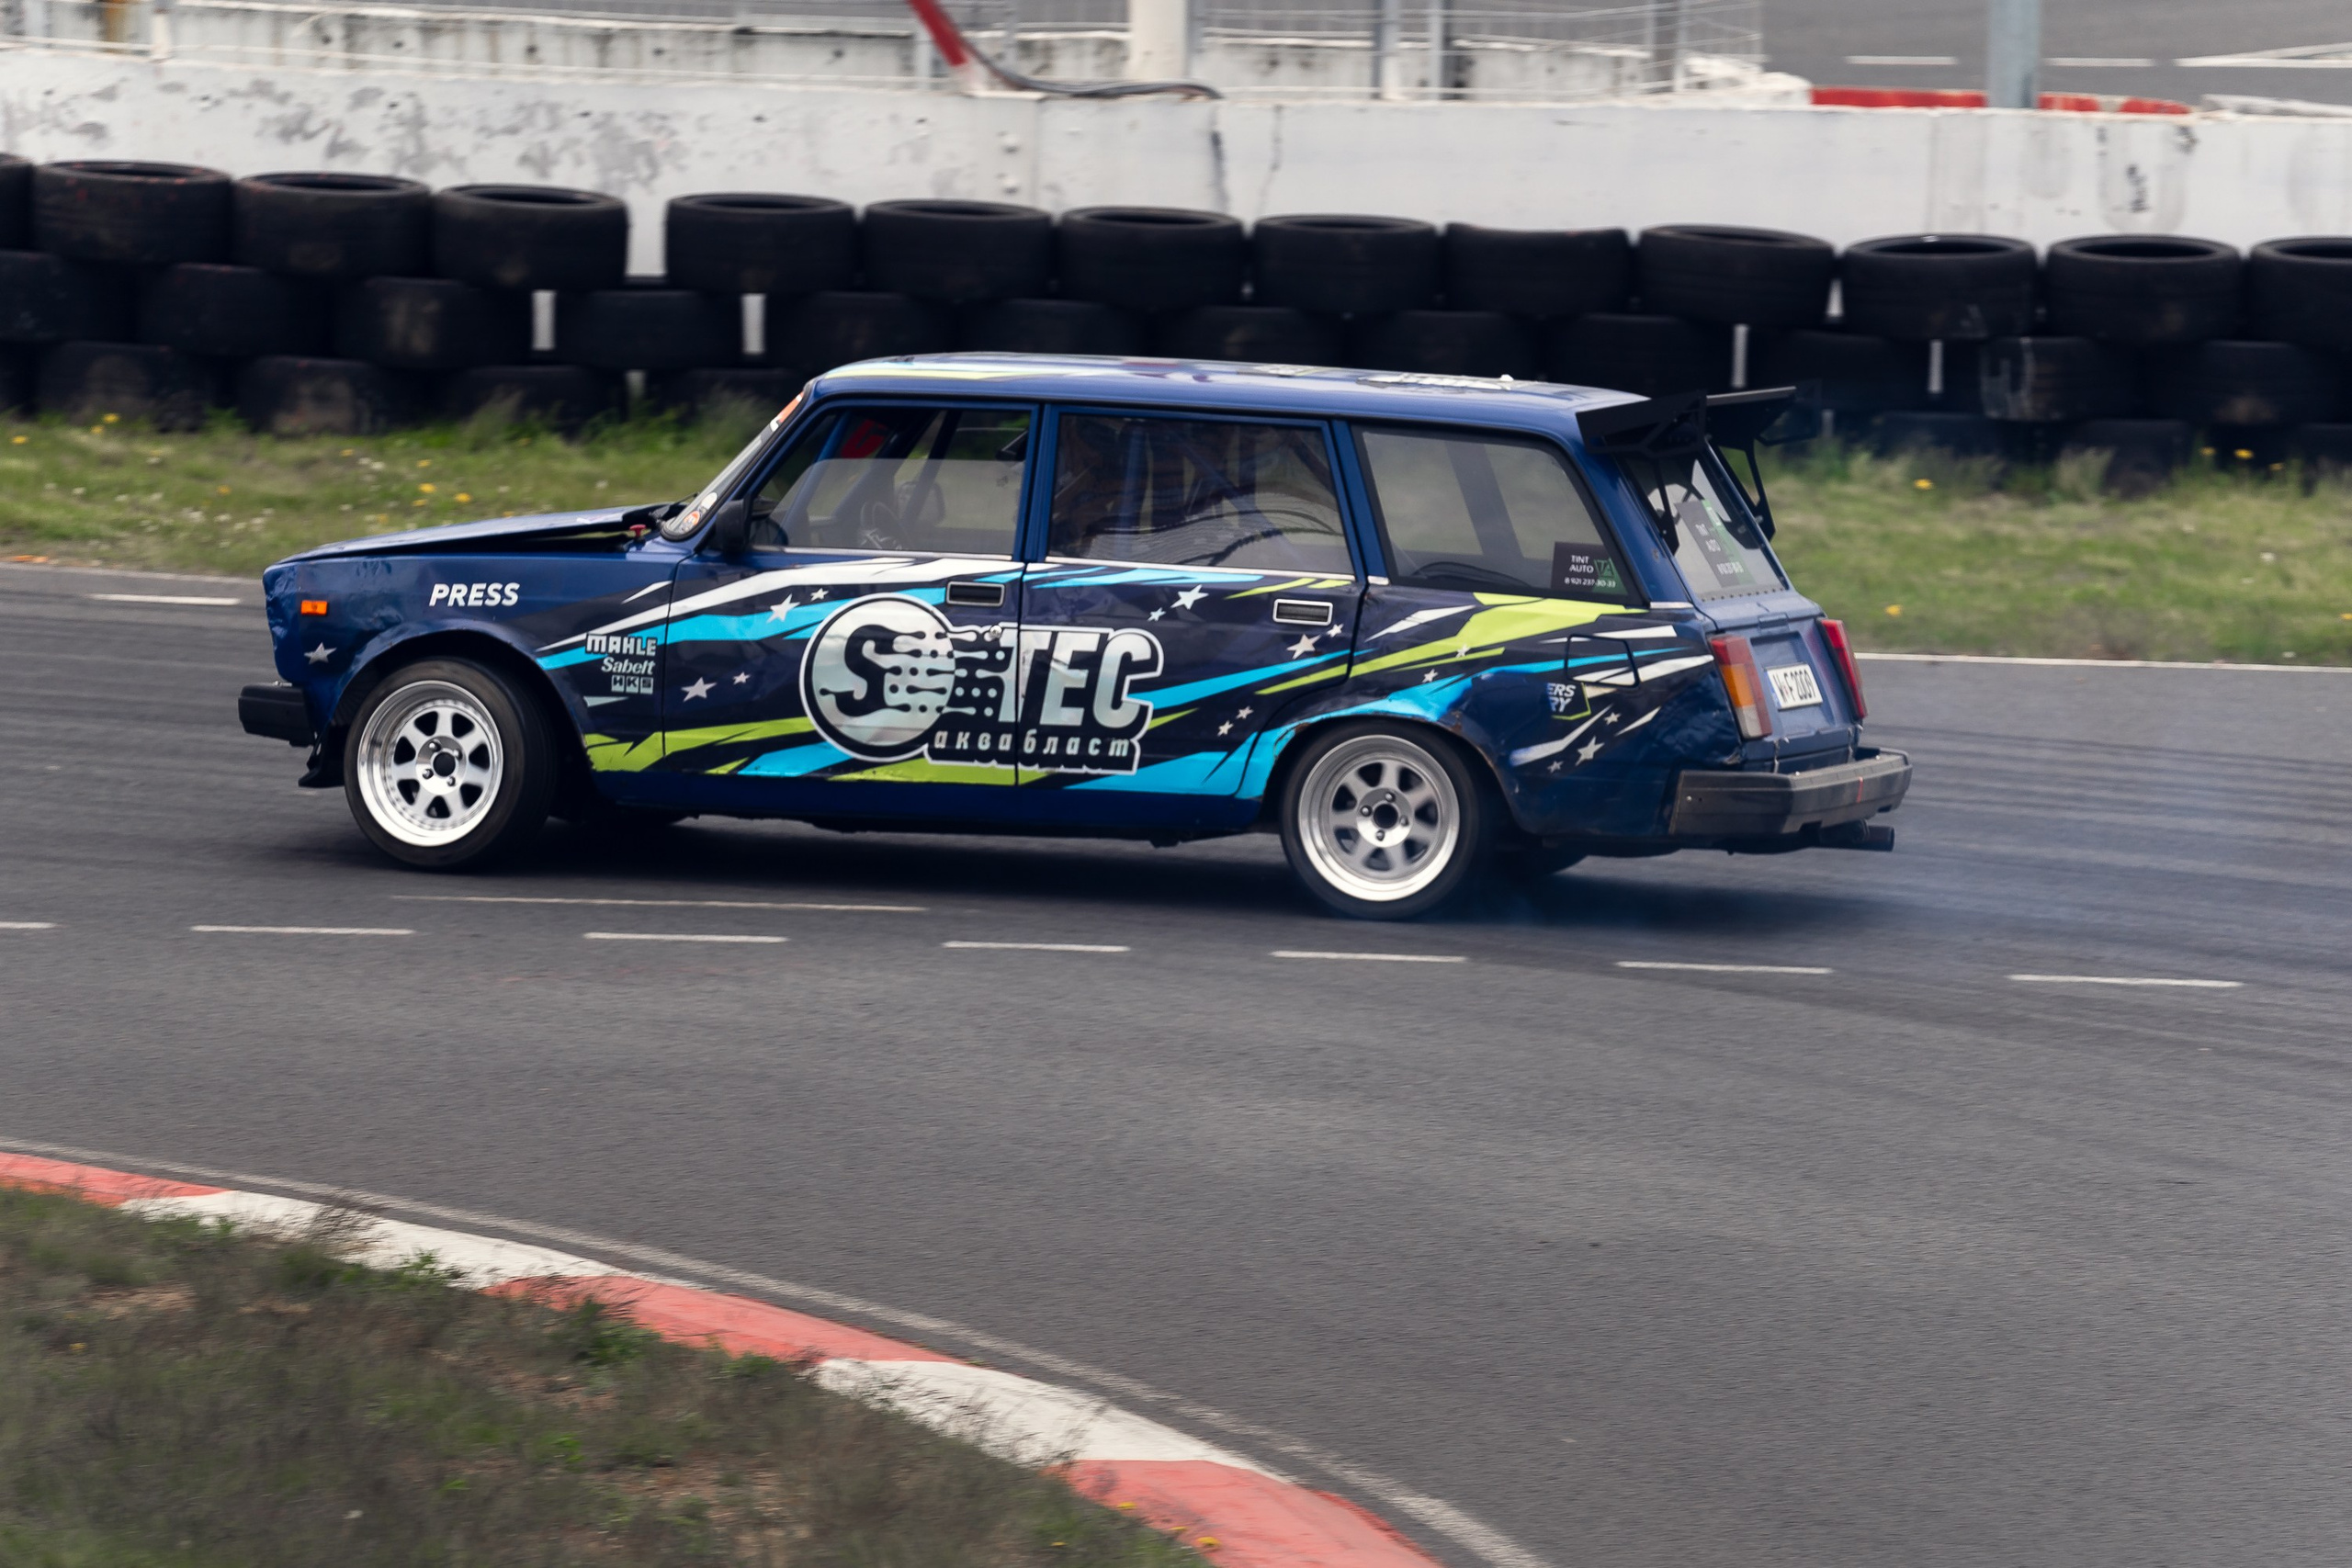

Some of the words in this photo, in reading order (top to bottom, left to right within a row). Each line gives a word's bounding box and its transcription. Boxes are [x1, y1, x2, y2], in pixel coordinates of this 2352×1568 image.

[1568, 564, 1594, 574] AUTO
[1570, 555, 1589, 564] TINT
[429, 582, 521, 606] PRESS
[586, 635, 657, 656] MAHLE
[601, 656, 656, 675] Sabelt
[933, 729, 1131, 757] аквабласт
